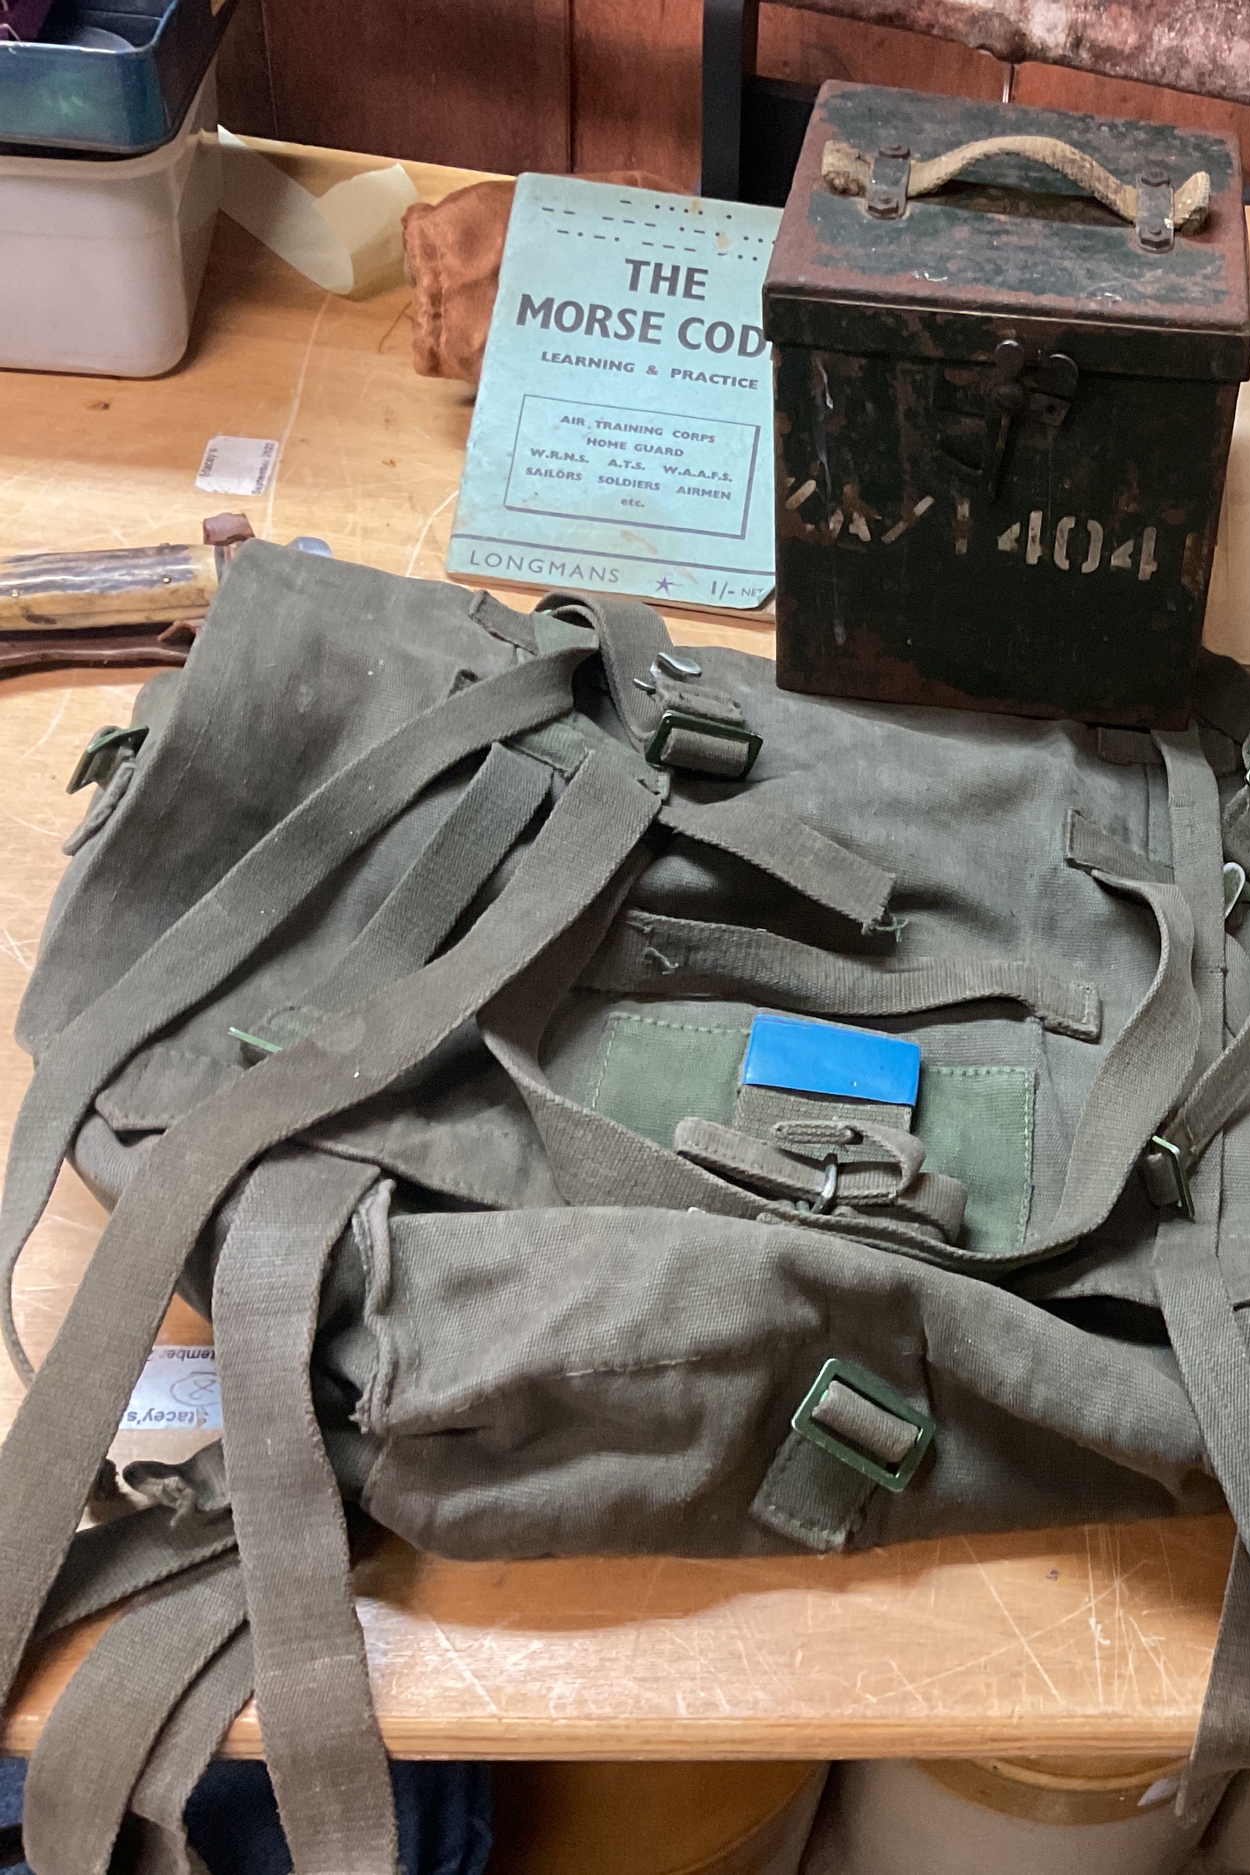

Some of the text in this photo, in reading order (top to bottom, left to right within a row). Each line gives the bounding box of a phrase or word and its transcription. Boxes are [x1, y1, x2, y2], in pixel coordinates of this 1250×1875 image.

[625, 258, 708, 301] THE
[515, 293, 768, 359] MORSE COD
[541, 351, 759, 390] LEARNING & PRACTICE
[560, 415, 716, 444] AIR TRAINING CORPS
[586, 437, 684, 457] HOME GUARD
[530, 448, 733, 482] W.R.N.S. A.T.S. W.A.A.F.S.
[525, 467, 732, 500] SAILORS SOLDIERS AIRMEN
[620, 498, 645, 508] etc.
[997, 510, 1158, 581] 404
[469, 550, 620, 583] LONGMANS
[741, 587, 765, 599] NET
[126, 1407, 210, 1425] tacey's
